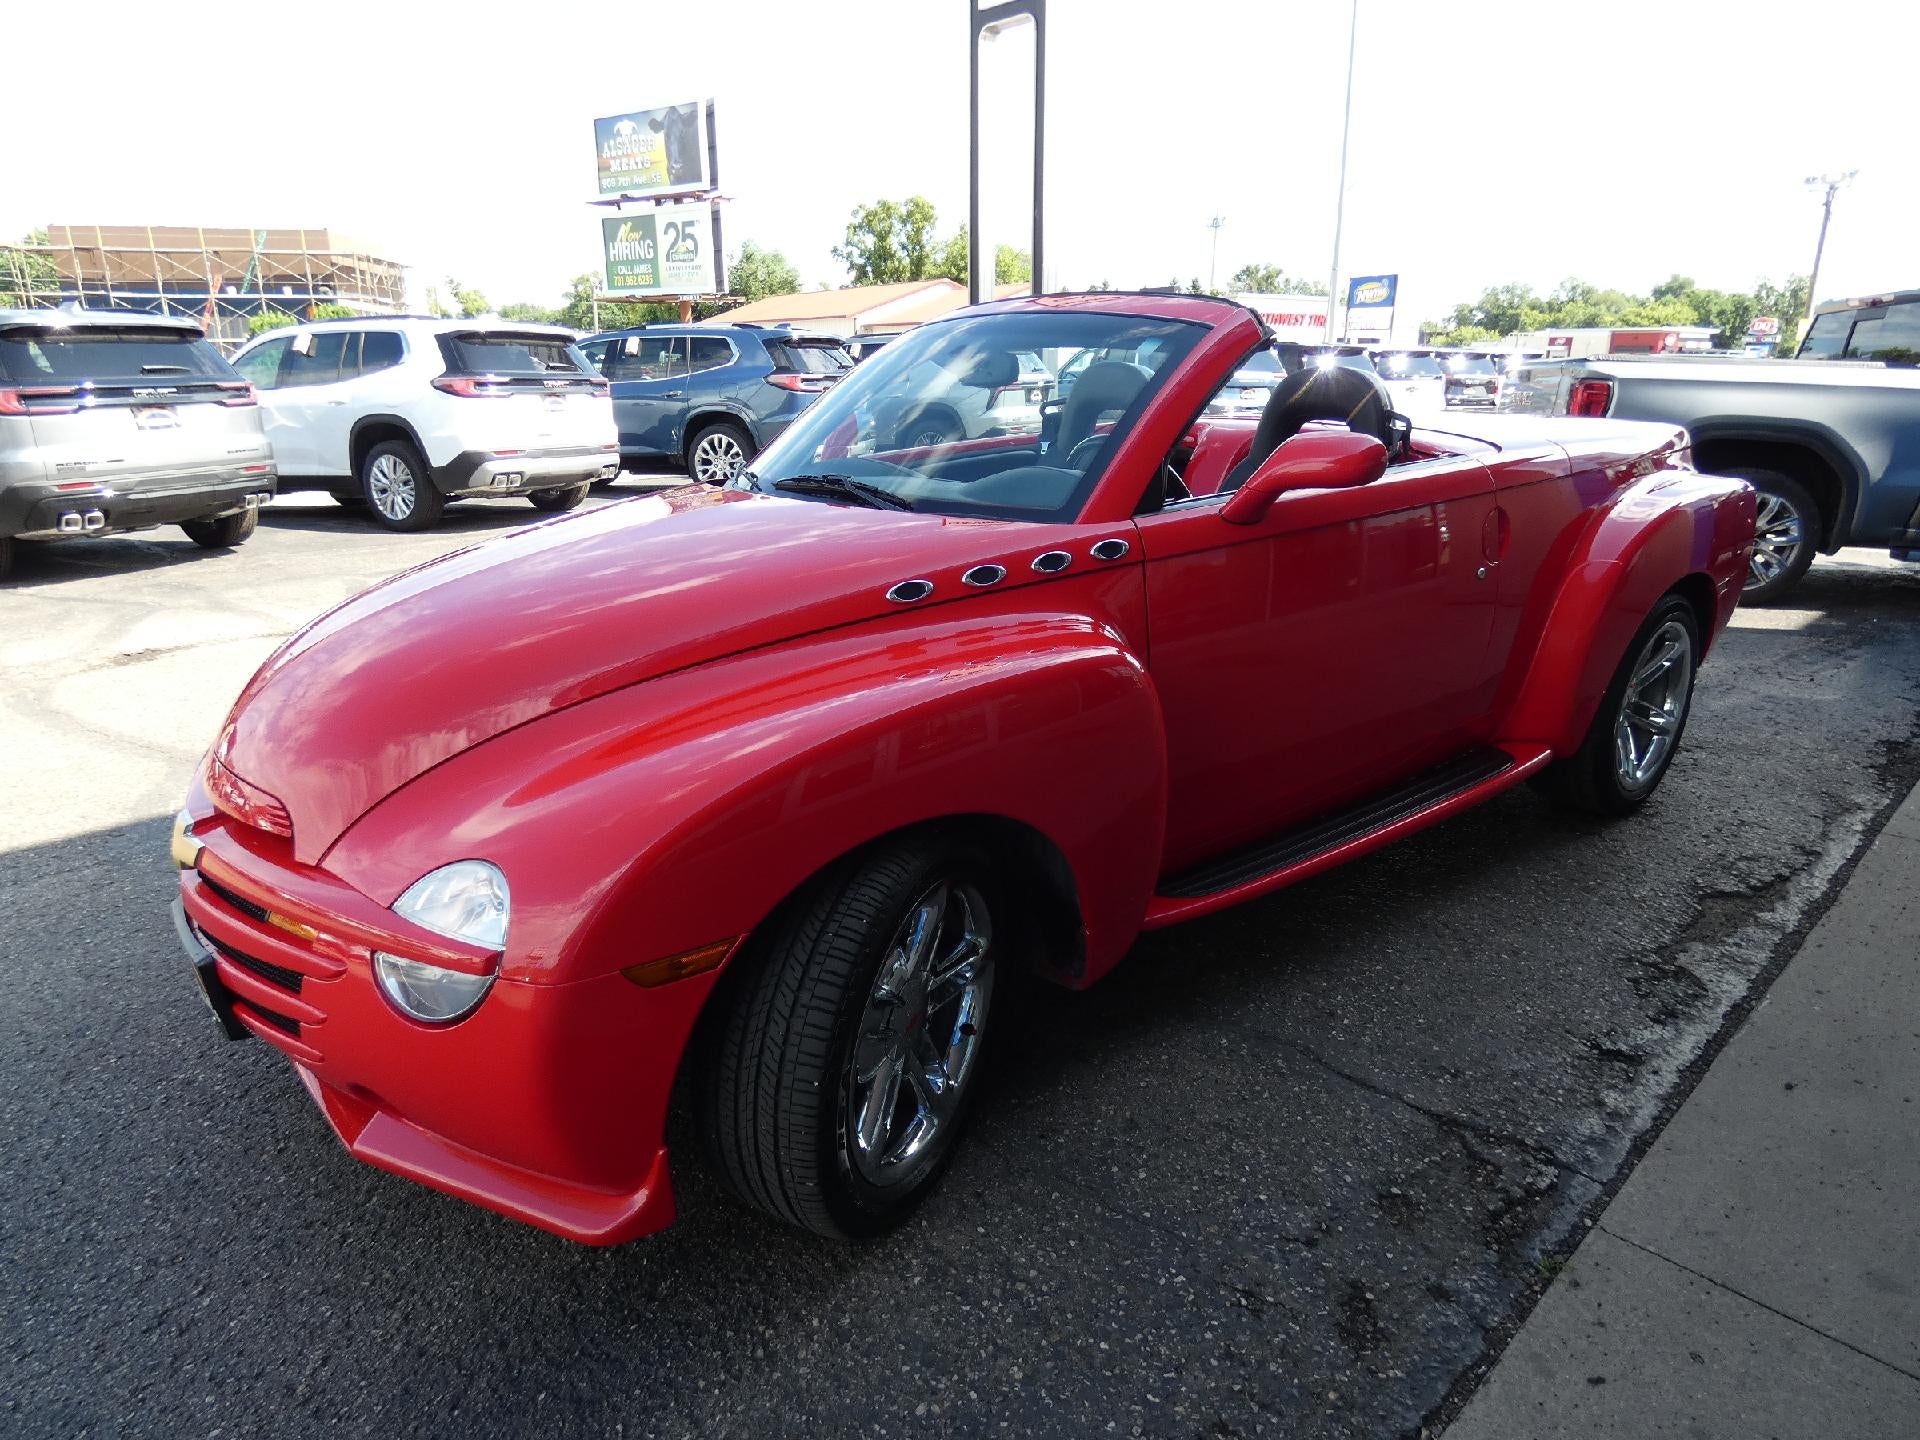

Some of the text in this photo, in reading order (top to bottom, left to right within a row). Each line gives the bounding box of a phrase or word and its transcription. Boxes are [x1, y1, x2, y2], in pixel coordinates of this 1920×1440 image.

[617, 221, 642, 243] Now
[609, 240, 654, 262] HIRING
[618, 264, 653, 275] CALL JAMES
